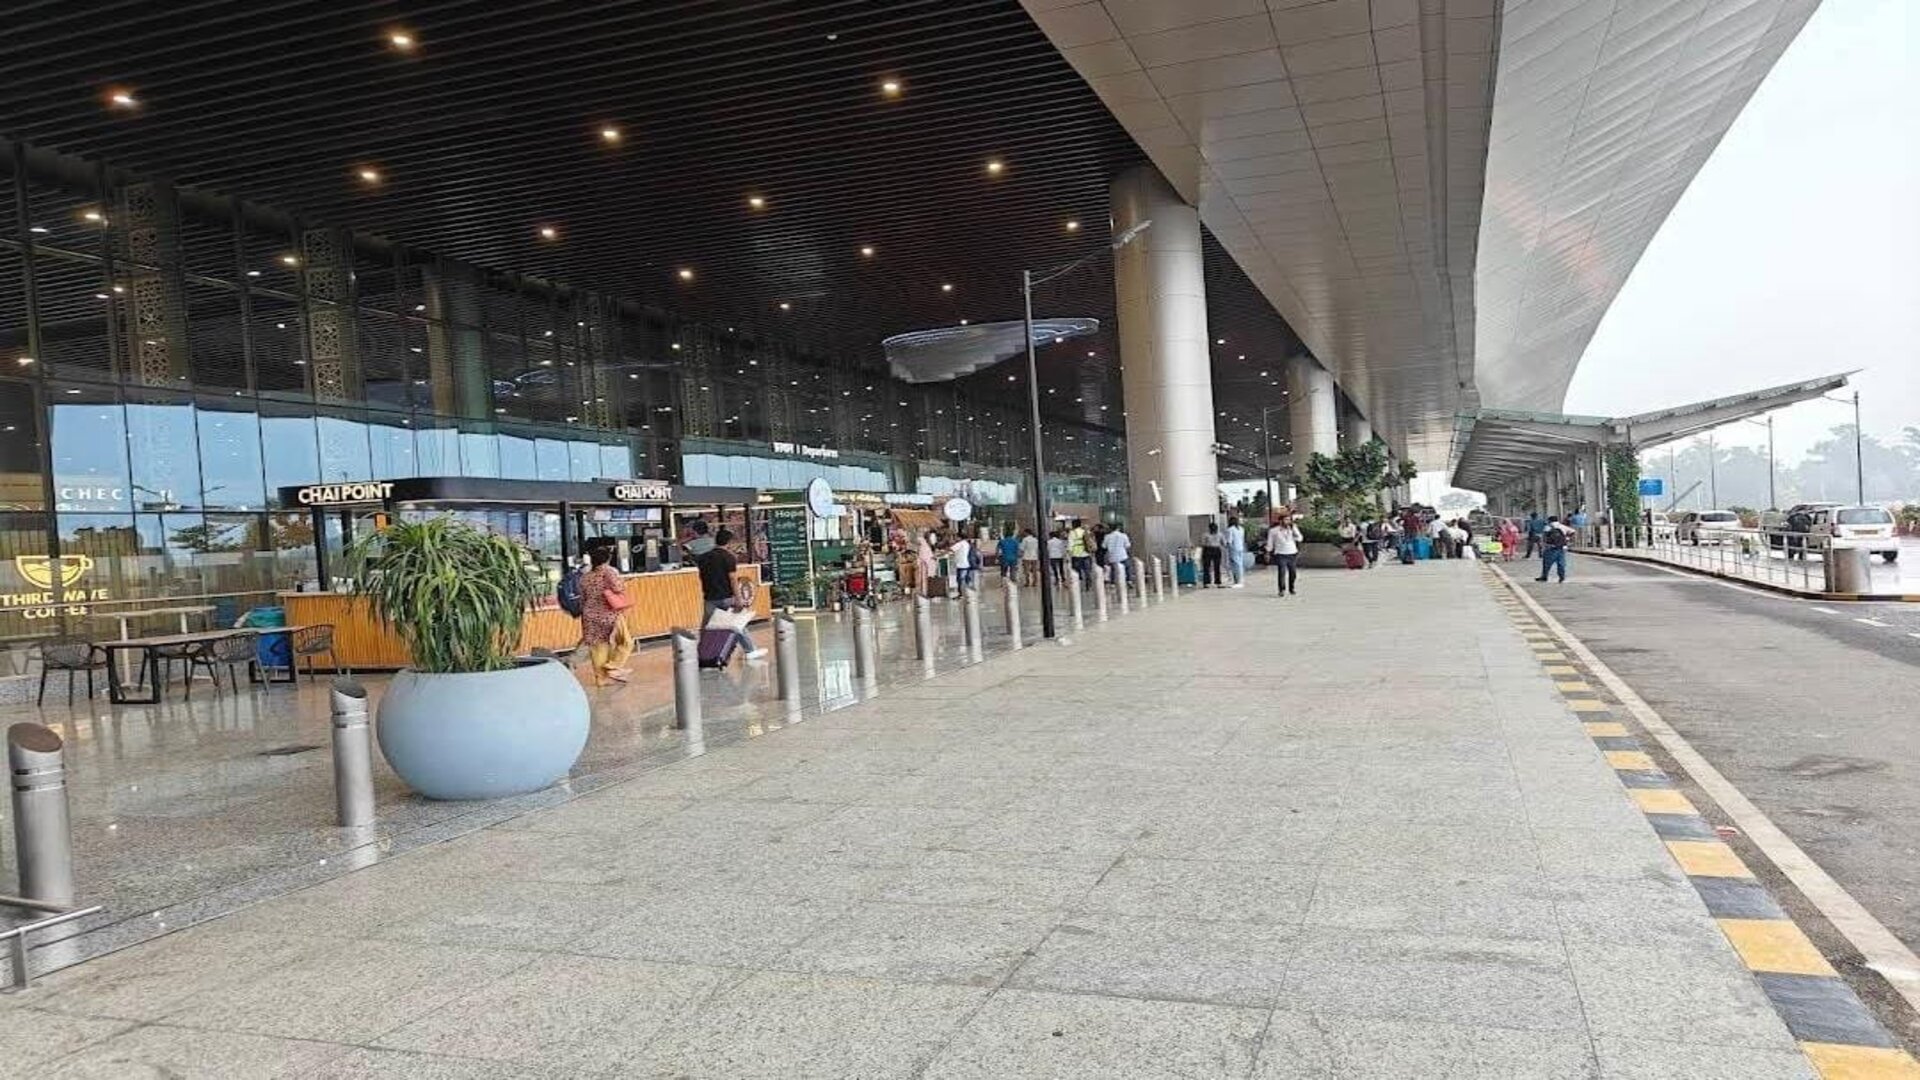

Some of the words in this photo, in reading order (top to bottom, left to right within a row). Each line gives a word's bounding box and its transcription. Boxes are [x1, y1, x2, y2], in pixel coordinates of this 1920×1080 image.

[61, 487, 138, 502] CHEC
[298, 486, 340, 504] CHAI
[341, 483, 394, 500] POINT
[614, 485, 642, 499] CHAI
[642, 485, 673, 500] POINT
